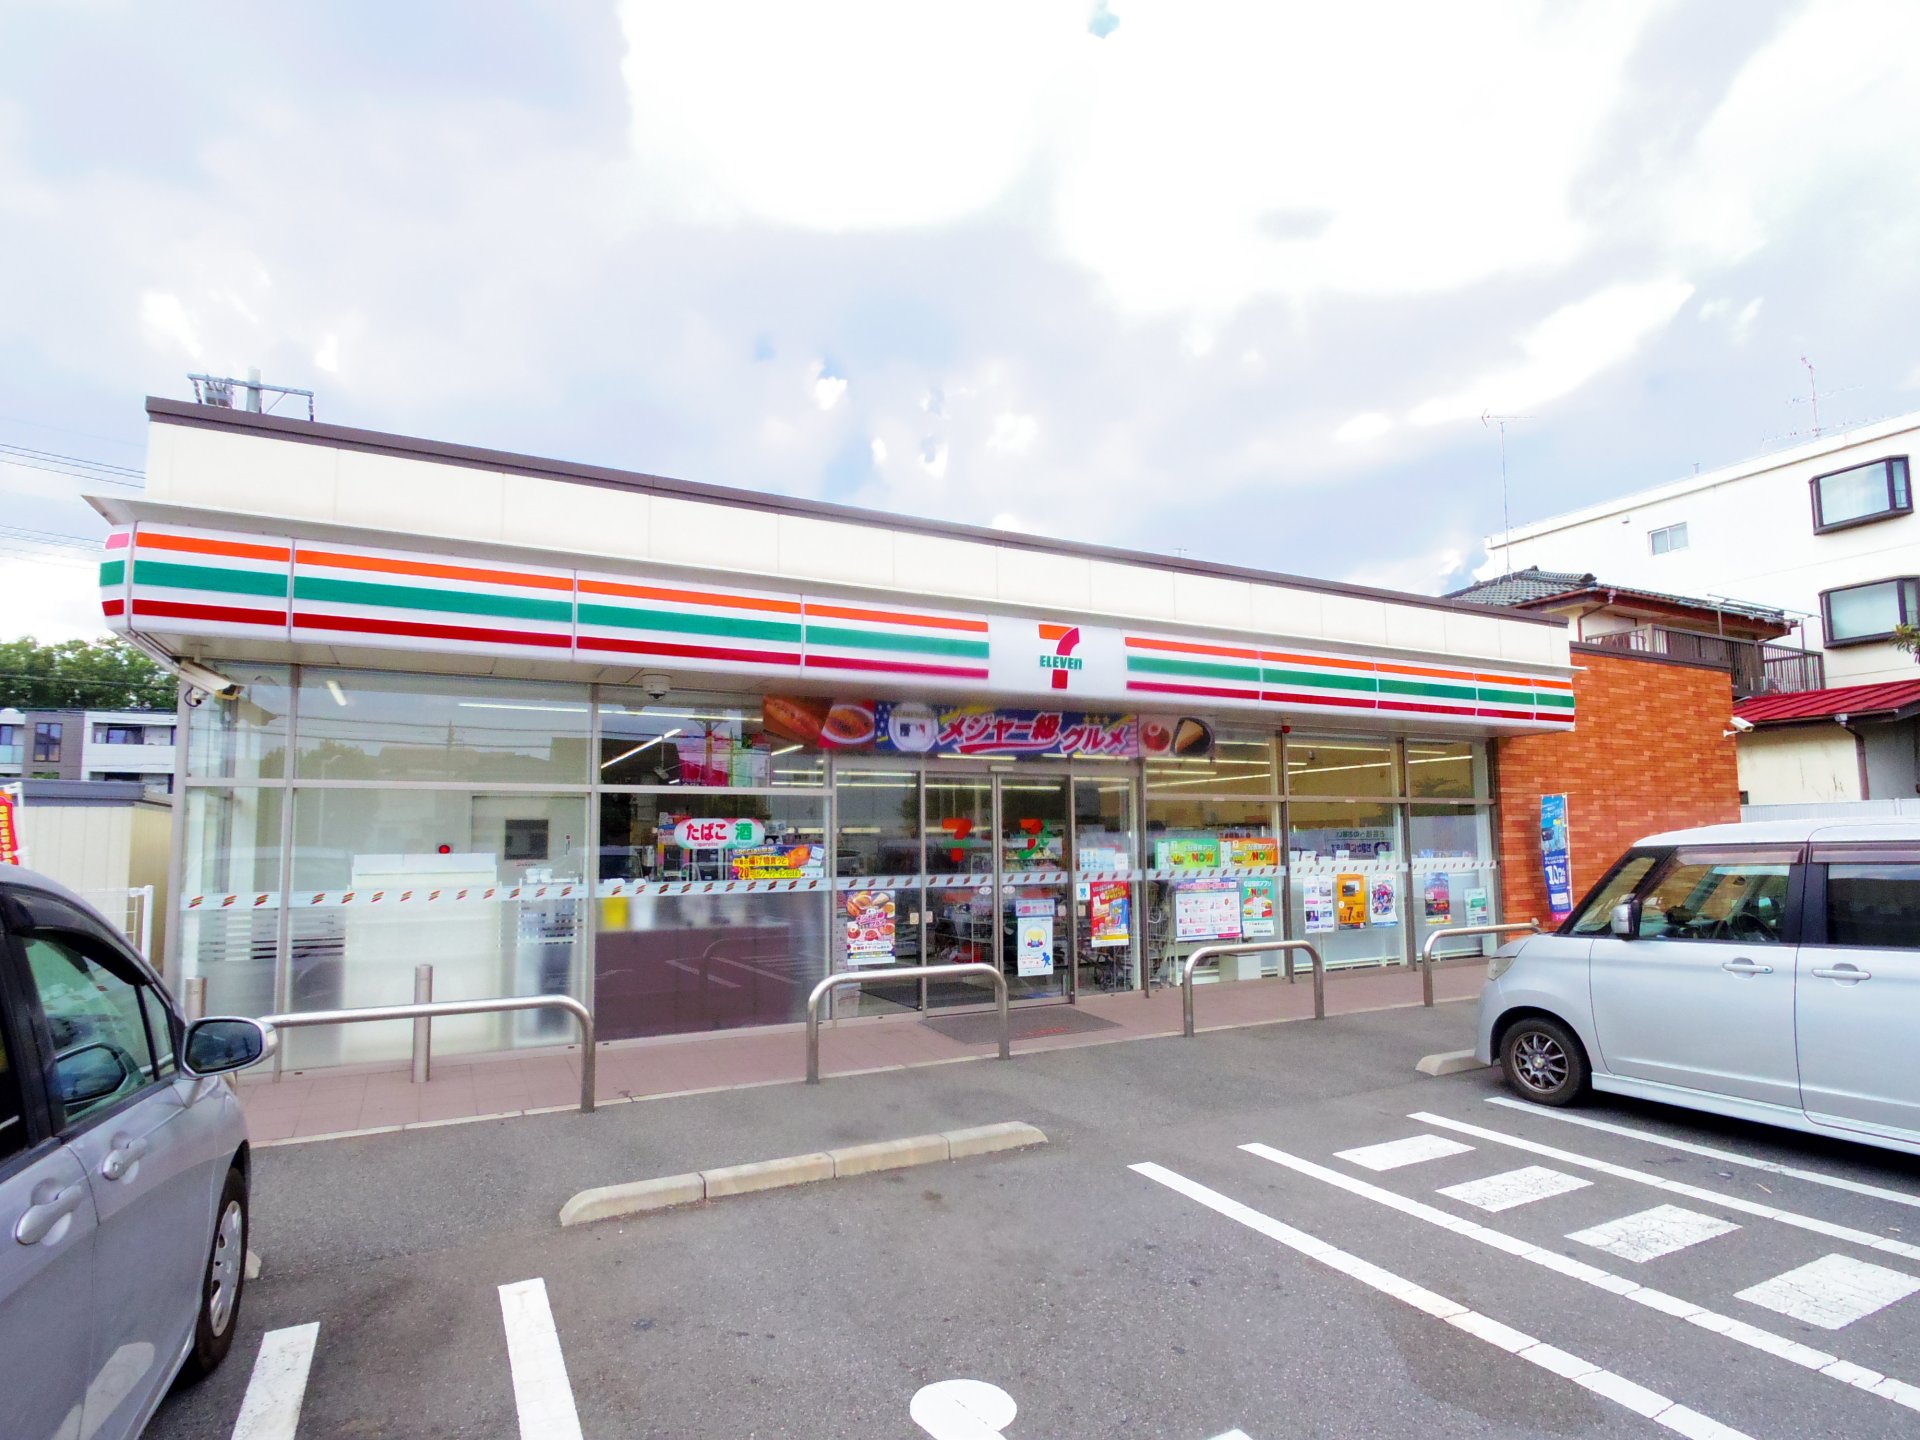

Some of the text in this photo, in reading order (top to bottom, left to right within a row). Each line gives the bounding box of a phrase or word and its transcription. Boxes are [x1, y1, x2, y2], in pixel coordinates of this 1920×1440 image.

[686, 822, 752, 841] たばこ 酒
